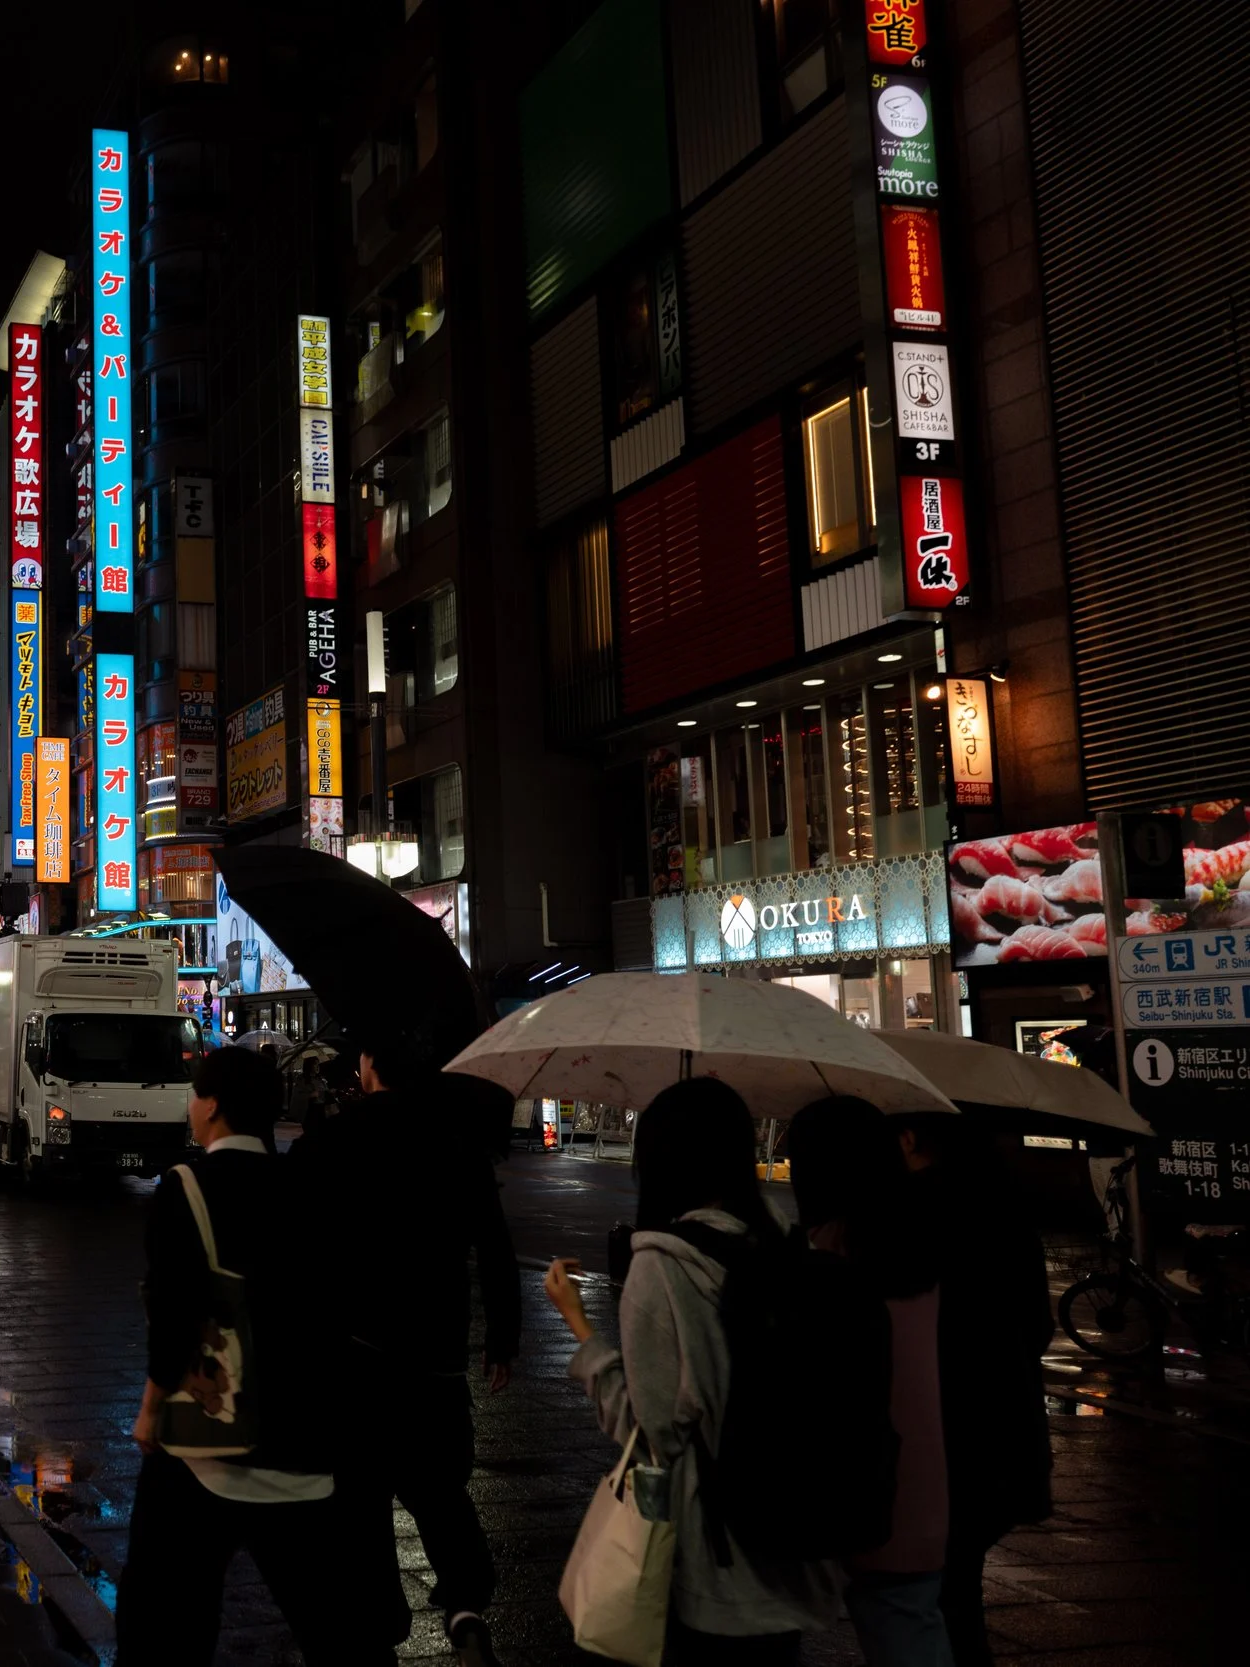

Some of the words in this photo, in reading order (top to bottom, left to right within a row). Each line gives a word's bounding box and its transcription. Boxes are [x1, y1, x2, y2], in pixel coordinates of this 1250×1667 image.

[867, 0, 919, 53] 雀
[911, 55, 927, 68] 6F
[871, 74, 888, 88] 5F
[881, 147, 923, 159] SHISHA
[878, 175, 939, 198] more
[902, 409, 948, 423] SHISHA
[14, 333, 40, 549] カラオケ歌広場
[915, 442, 940, 461] 3F
[924, 480, 942, 531] 居酒屋
[917, 533, 955, 590] 一休
[955, 597, 970, 606] 2F
[16, 603, 37, 624] 薬
[308, 609, 318, 627] BAR
[308, 638, 318, 658] PUB
[318, 607, 337, 685] AGEHA
[316, 683, 330, 695] 2F
[42, 742, 65, 753] TIME
[42, 751, 65, 762] CAFE
[20, 753, 34, 783] Shop
[102, 673, 131, 891] カラオケ館
[230, 758, 283, 808] アウトレット
[957, 783, 990, 795] 24時間
[20, 782, 33, 806] Free
[187, 795, 212, 806] 729
[956, 794, 992, 806] 年中無休
[20, 803, 33, 828] Tax
[44, 767, 63, 879] タイム珈琲店
[759, 893, 867, 931] OKURA
[796, 929, 834, 946] TOKYO
[1132, 963, 1161, 974] 340m
[1215, 959, 1228, 970] JR
[1136, 986, 1233, 1008] 西武新宿駅
[1139, 1009, 1214, 1023] Seibu-Shinjuku
[1216, 1008, 1236, 1021] Sta.
[1178, 1066, 1234, 1082] Shinjuku
[1237, 1064, 1250, 1080] Ci
[112, 1110, 147, 1118] ISUZU
[1170, 1139, 1217, 1158] 新宿区
[1158, 1157, 1219, 1179] 歌舞伎町
[1184, 1180, 1222, 1200] 1-18
